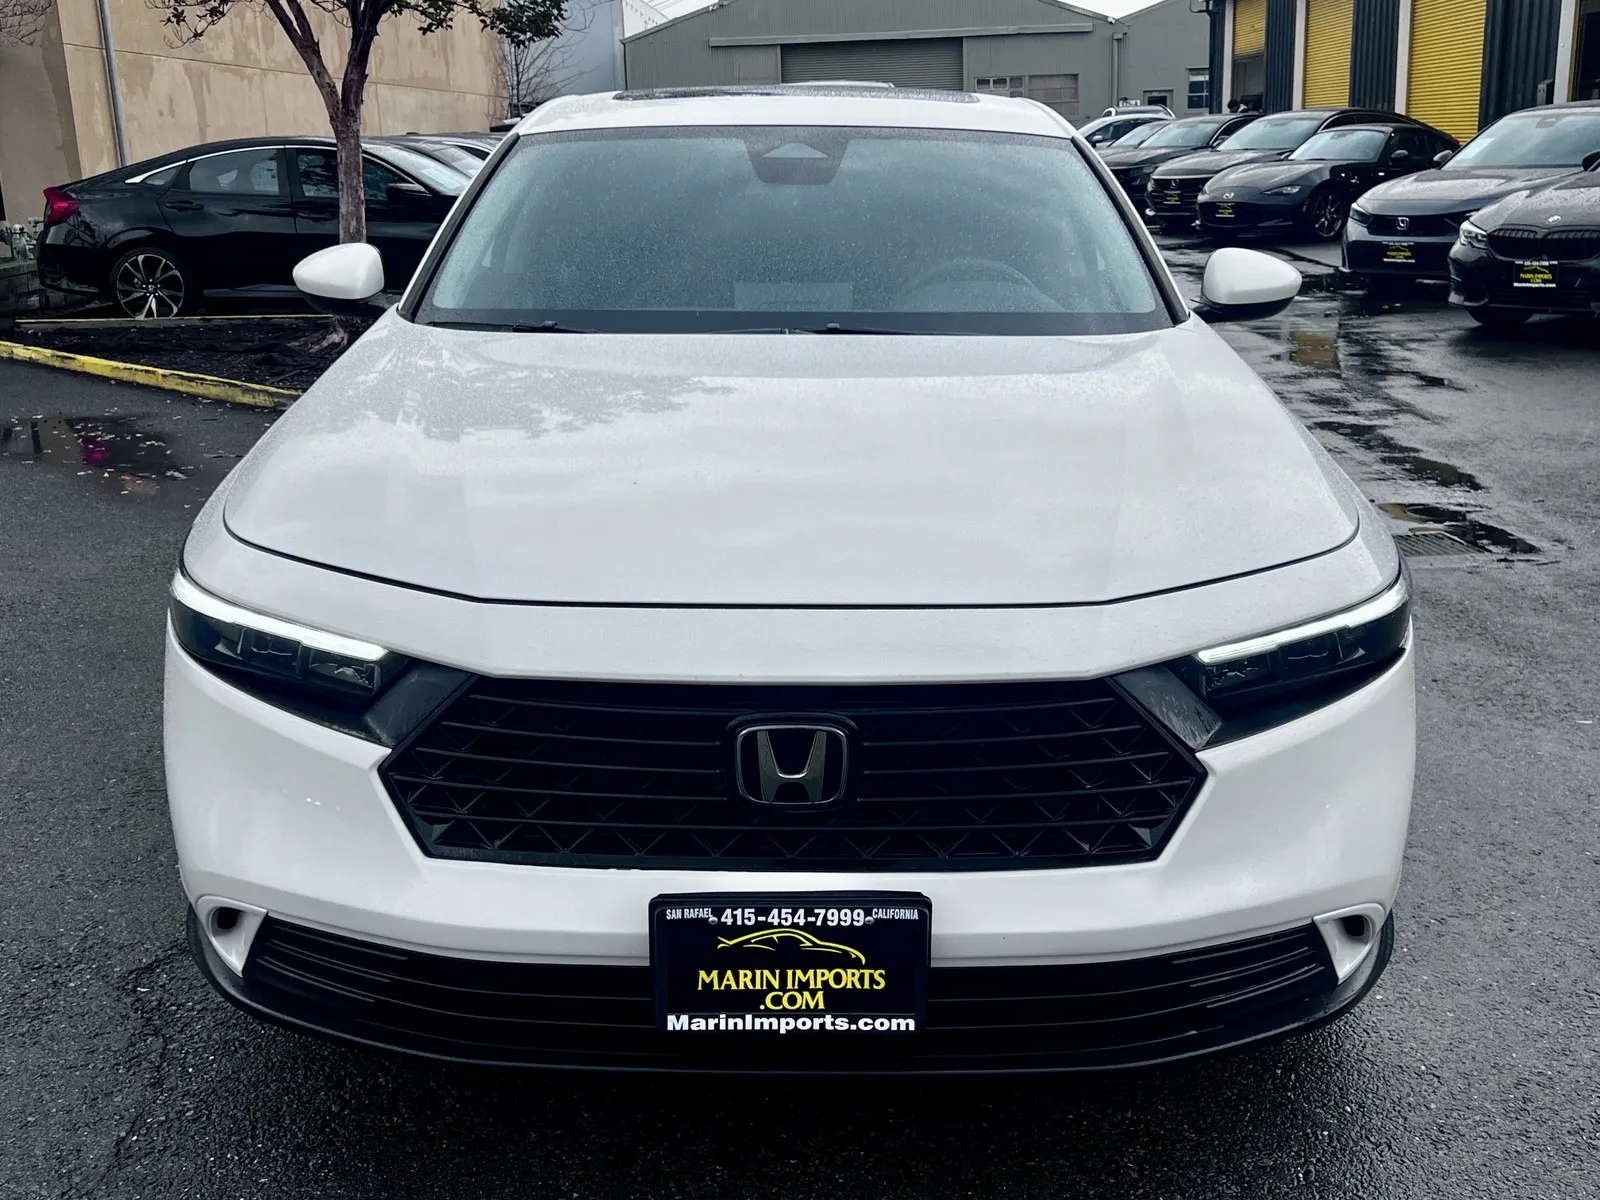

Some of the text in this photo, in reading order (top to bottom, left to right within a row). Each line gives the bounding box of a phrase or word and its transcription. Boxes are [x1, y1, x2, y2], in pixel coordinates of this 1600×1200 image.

[665, 907, 919, 926] SAN RAFAEL 415-454-7999 CALIFORNIA
[697, 968, 886, 990] MARIN IMPORTS
[759, 991, 826, 1010] .COM
[666, 1013, 916, 1034] MarinImports.com
